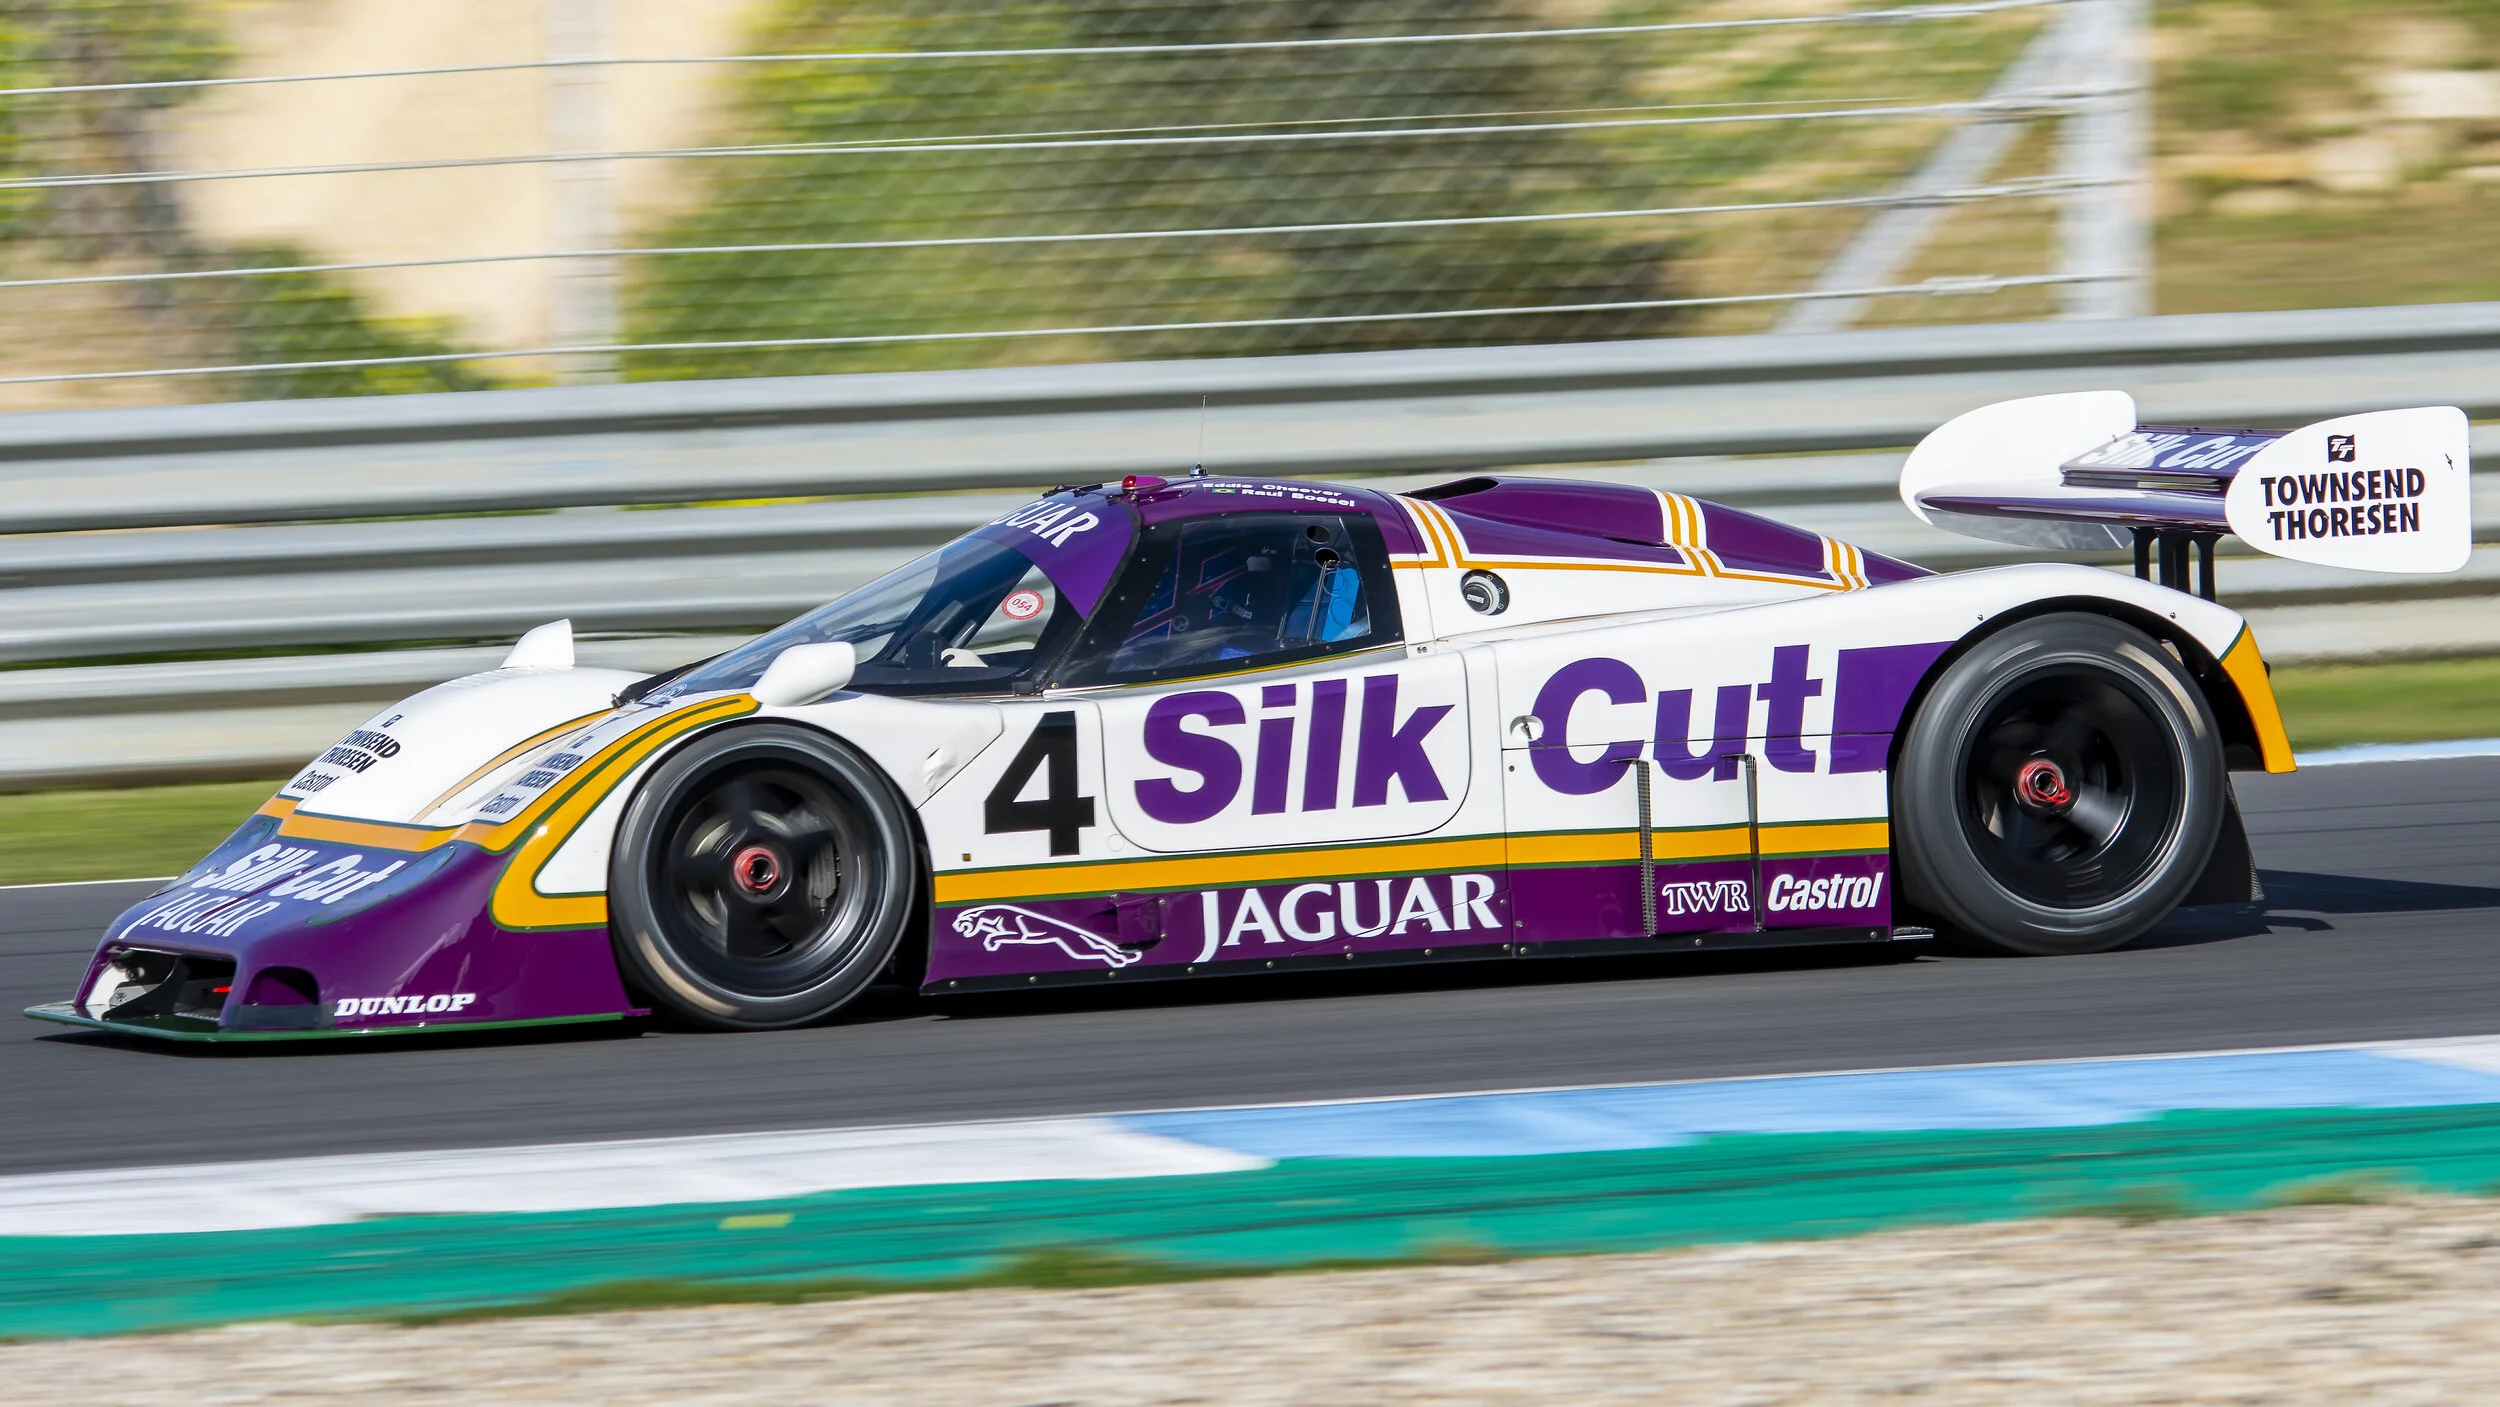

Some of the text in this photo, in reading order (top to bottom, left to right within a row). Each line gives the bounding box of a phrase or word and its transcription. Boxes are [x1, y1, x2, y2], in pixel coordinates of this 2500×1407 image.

[2078, 433, 2278, 469] Silk Cut
[1241, 489, 1356, 507] Raul Boesel
[1262, 484, 1342, 497] Cheever
[2260, 467, 2426, 507] TOWNSEND
[989, 501, 1100, 548] GUAR
[2269, 502, 2421, 541] THORESEN
[1012, 598, 1033, 611] 054
[340, 730, 401, 758] TOWNSEND
[1134, 644, 1823, 825] Silk Cut
[318, 746, 378, 774] THORESEN
[291, 770, 340, 793] Castrol
[984, 710, 1095, 857] 4
[190, 843, 407, 904] Silk Cut
[1661, 872, 1884, 915] TWR Castrol
[118, 891, 281, 938] JAGUAR
[1192, 873, 1503, 964] JAGUAR
[333, 992, 477, 1017] DUNLOP
